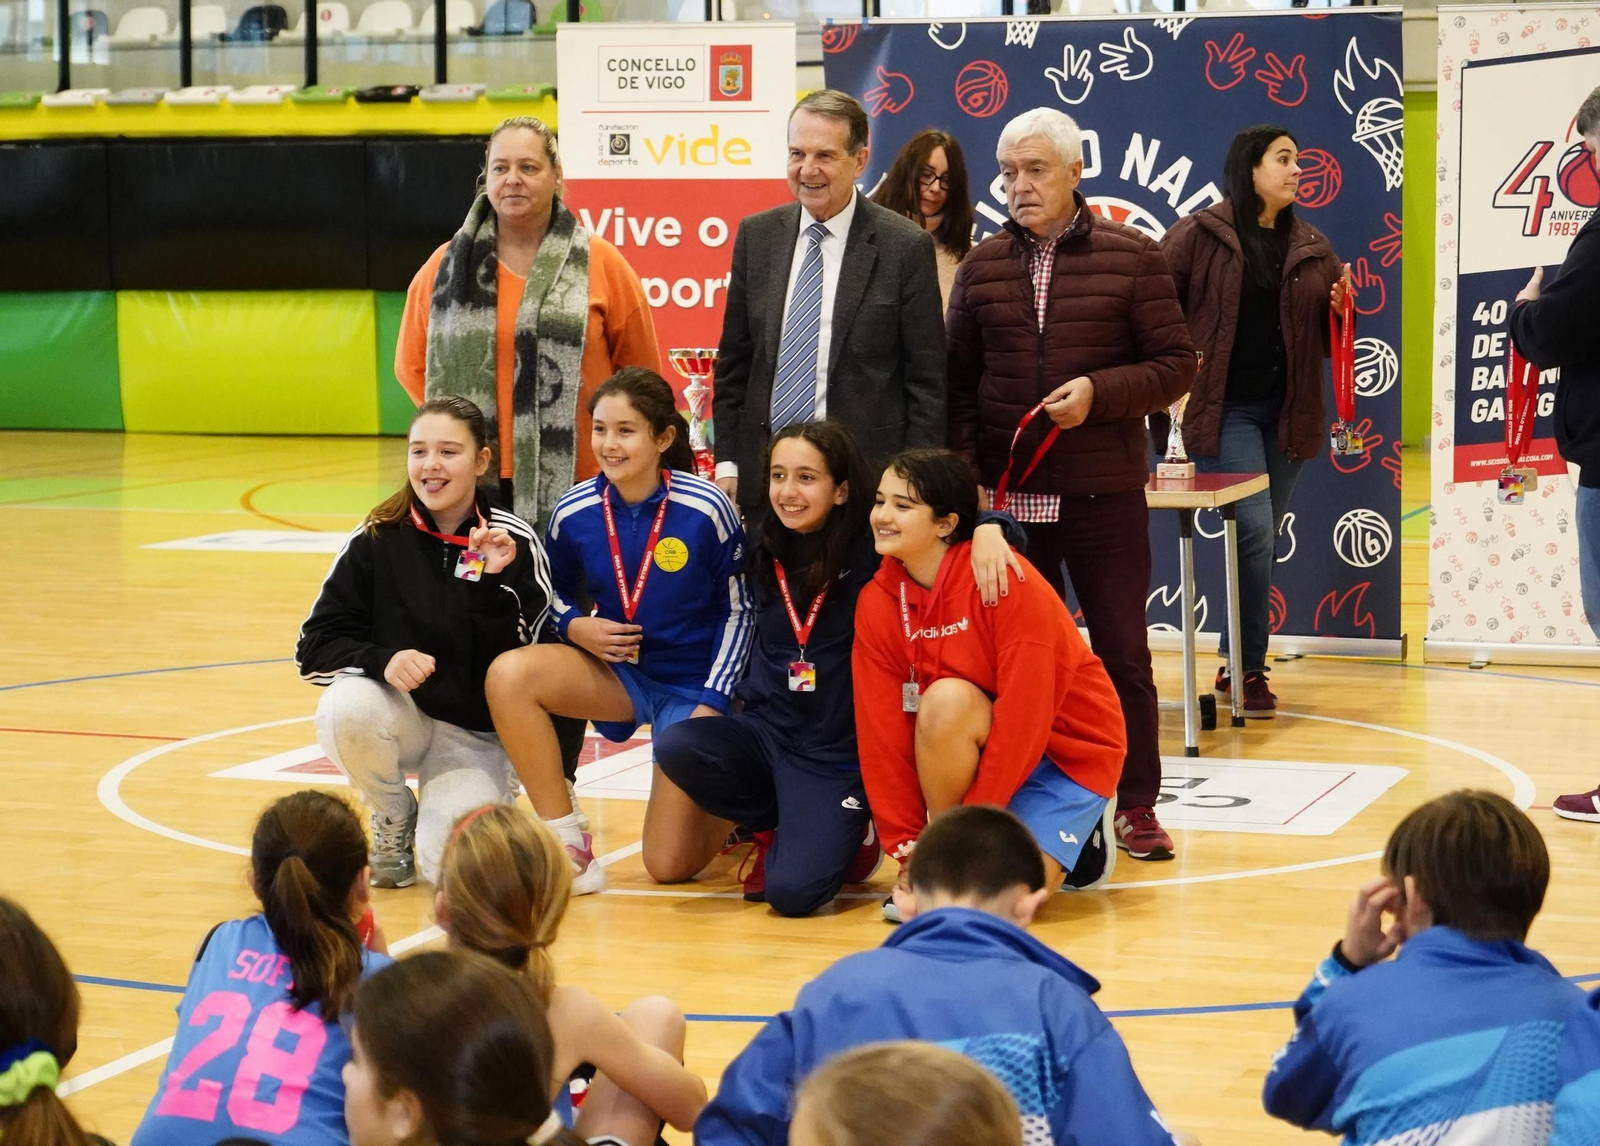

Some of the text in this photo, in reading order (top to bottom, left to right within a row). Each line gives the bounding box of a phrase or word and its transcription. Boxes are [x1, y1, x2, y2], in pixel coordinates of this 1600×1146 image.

[606, 57, 696, 72] CONCELLO
[617, 76, 686, 90] DE VIGO
[642, 123, 752, 166] vide
[578, 206, 729, 248] Vive o
[1548, 222, 1579, 236] 1983
[1549, 210, 1595, 221] ANIVERS
[1472, 300, 1507, 327] 40
[1471, 331, 1507, 359] DE
[613, 554, 621, 570] VIGO
[632, 550, 653, 603] CONCELLO DE VIGO
[619, 578, 630, 609] CONCELLO
[903, 613, 909, 622] DE
[154, 990, 327, 1135] 28
